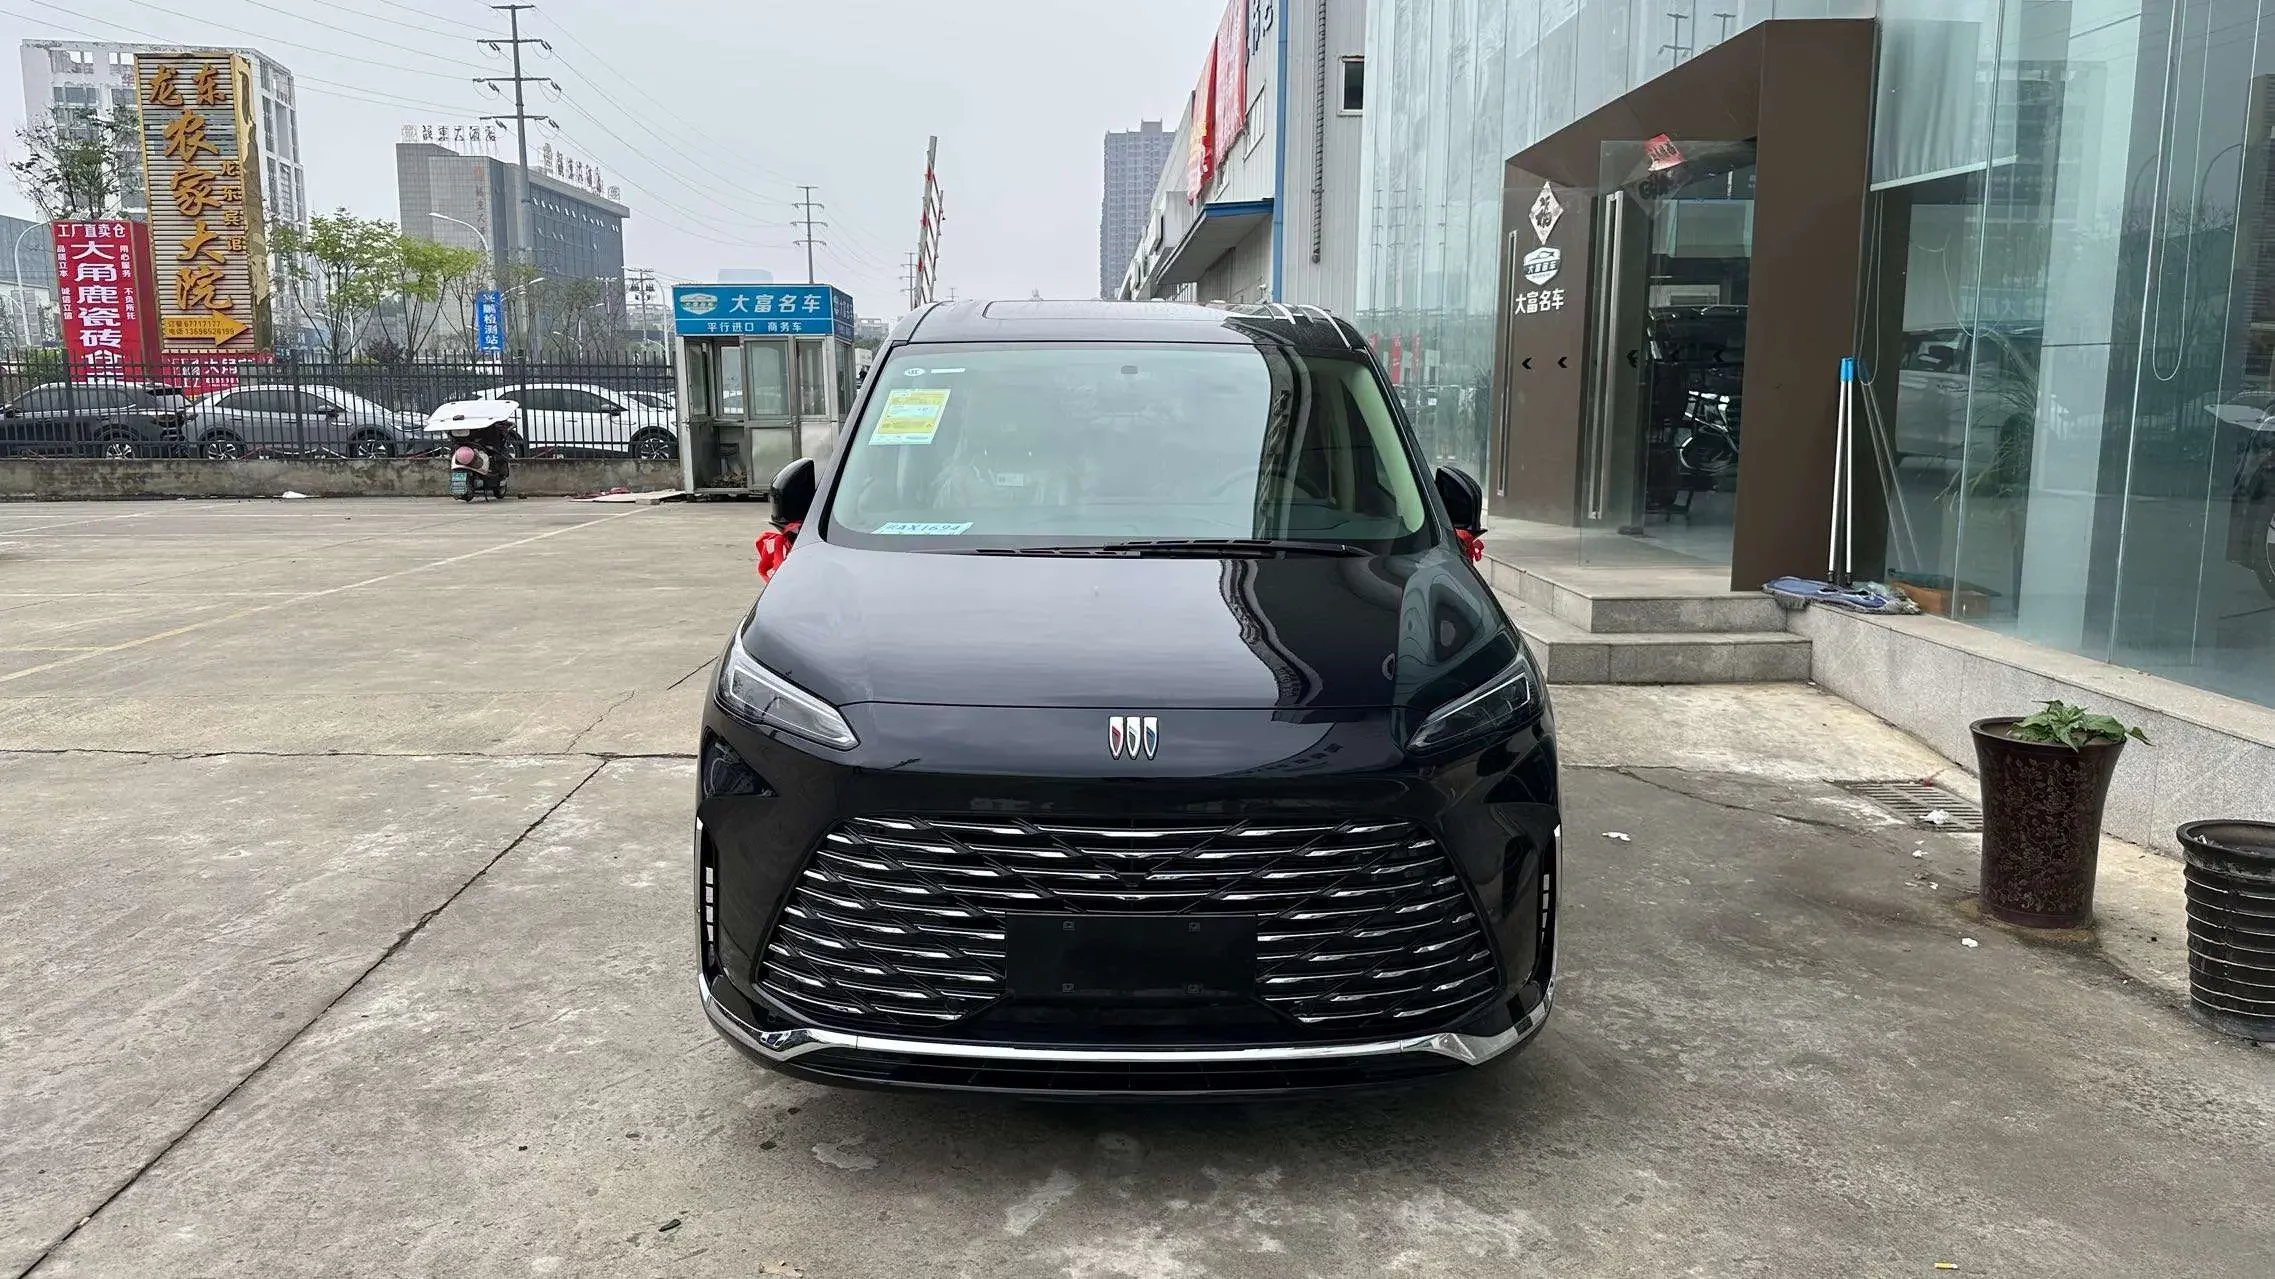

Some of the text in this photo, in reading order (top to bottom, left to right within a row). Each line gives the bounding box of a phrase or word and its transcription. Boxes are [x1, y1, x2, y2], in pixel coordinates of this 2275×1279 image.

[163, 108, 233, 310] 农家大院
[57, 223, 126, 238] 工厂直卖仓
[119, 245, 132, 278] 用心服务
[123, 287, 137, 320] 不负所托
[729, 294, 822, 313] 大富名车
[1514, 288, 1565, 315] 大富名车
[707, 321, 802, 332] 平行进口 商务车
